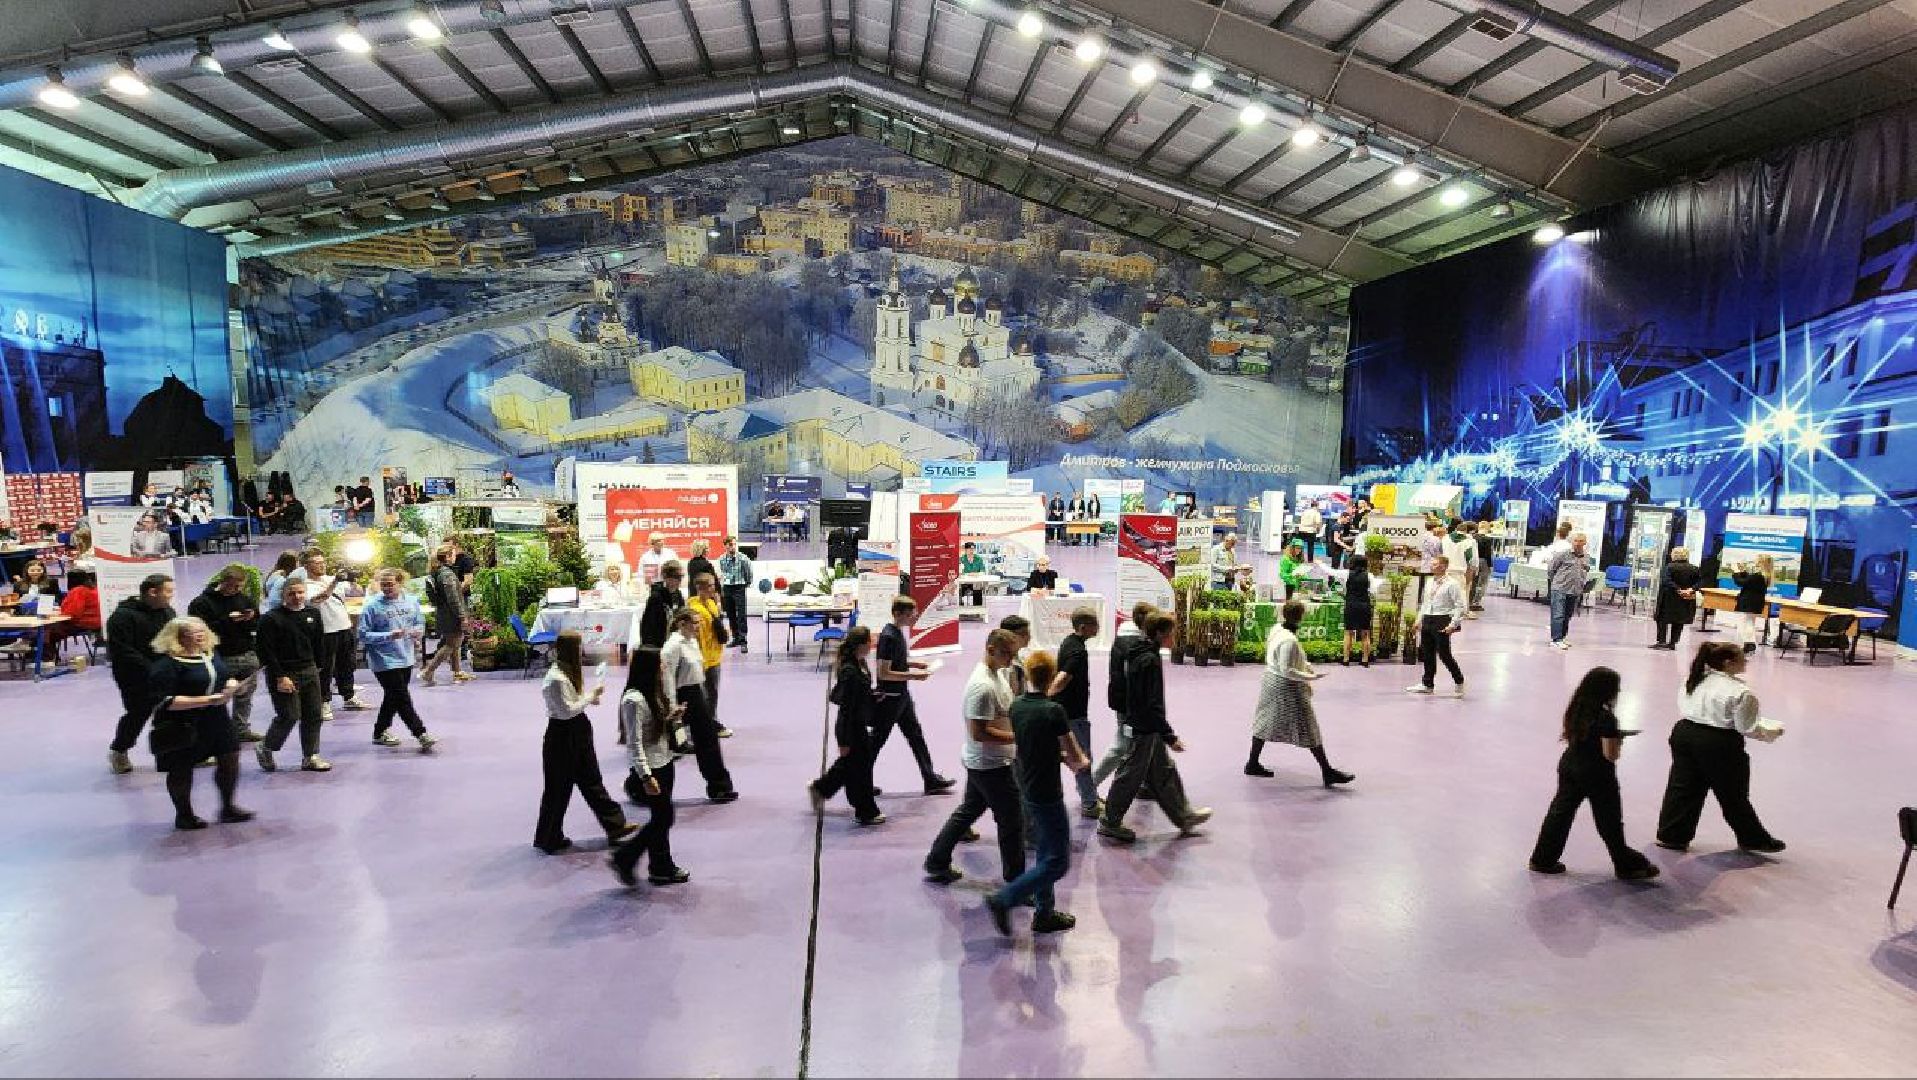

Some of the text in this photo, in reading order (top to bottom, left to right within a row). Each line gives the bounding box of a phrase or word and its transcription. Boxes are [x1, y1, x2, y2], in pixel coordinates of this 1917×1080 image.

[1060, 453, 1127, 468] Дмитров
[1135, 458, 1214, 473] жемчужина
[1216, 458, 1300, 473] Подмосковья
[924, 466, 977, 477] STAIRS
[1178, 526, 1193, 537] AIR
[1194, 526, 1210, 537] POT
[1381, 527, 1419, 537] BOSCO
